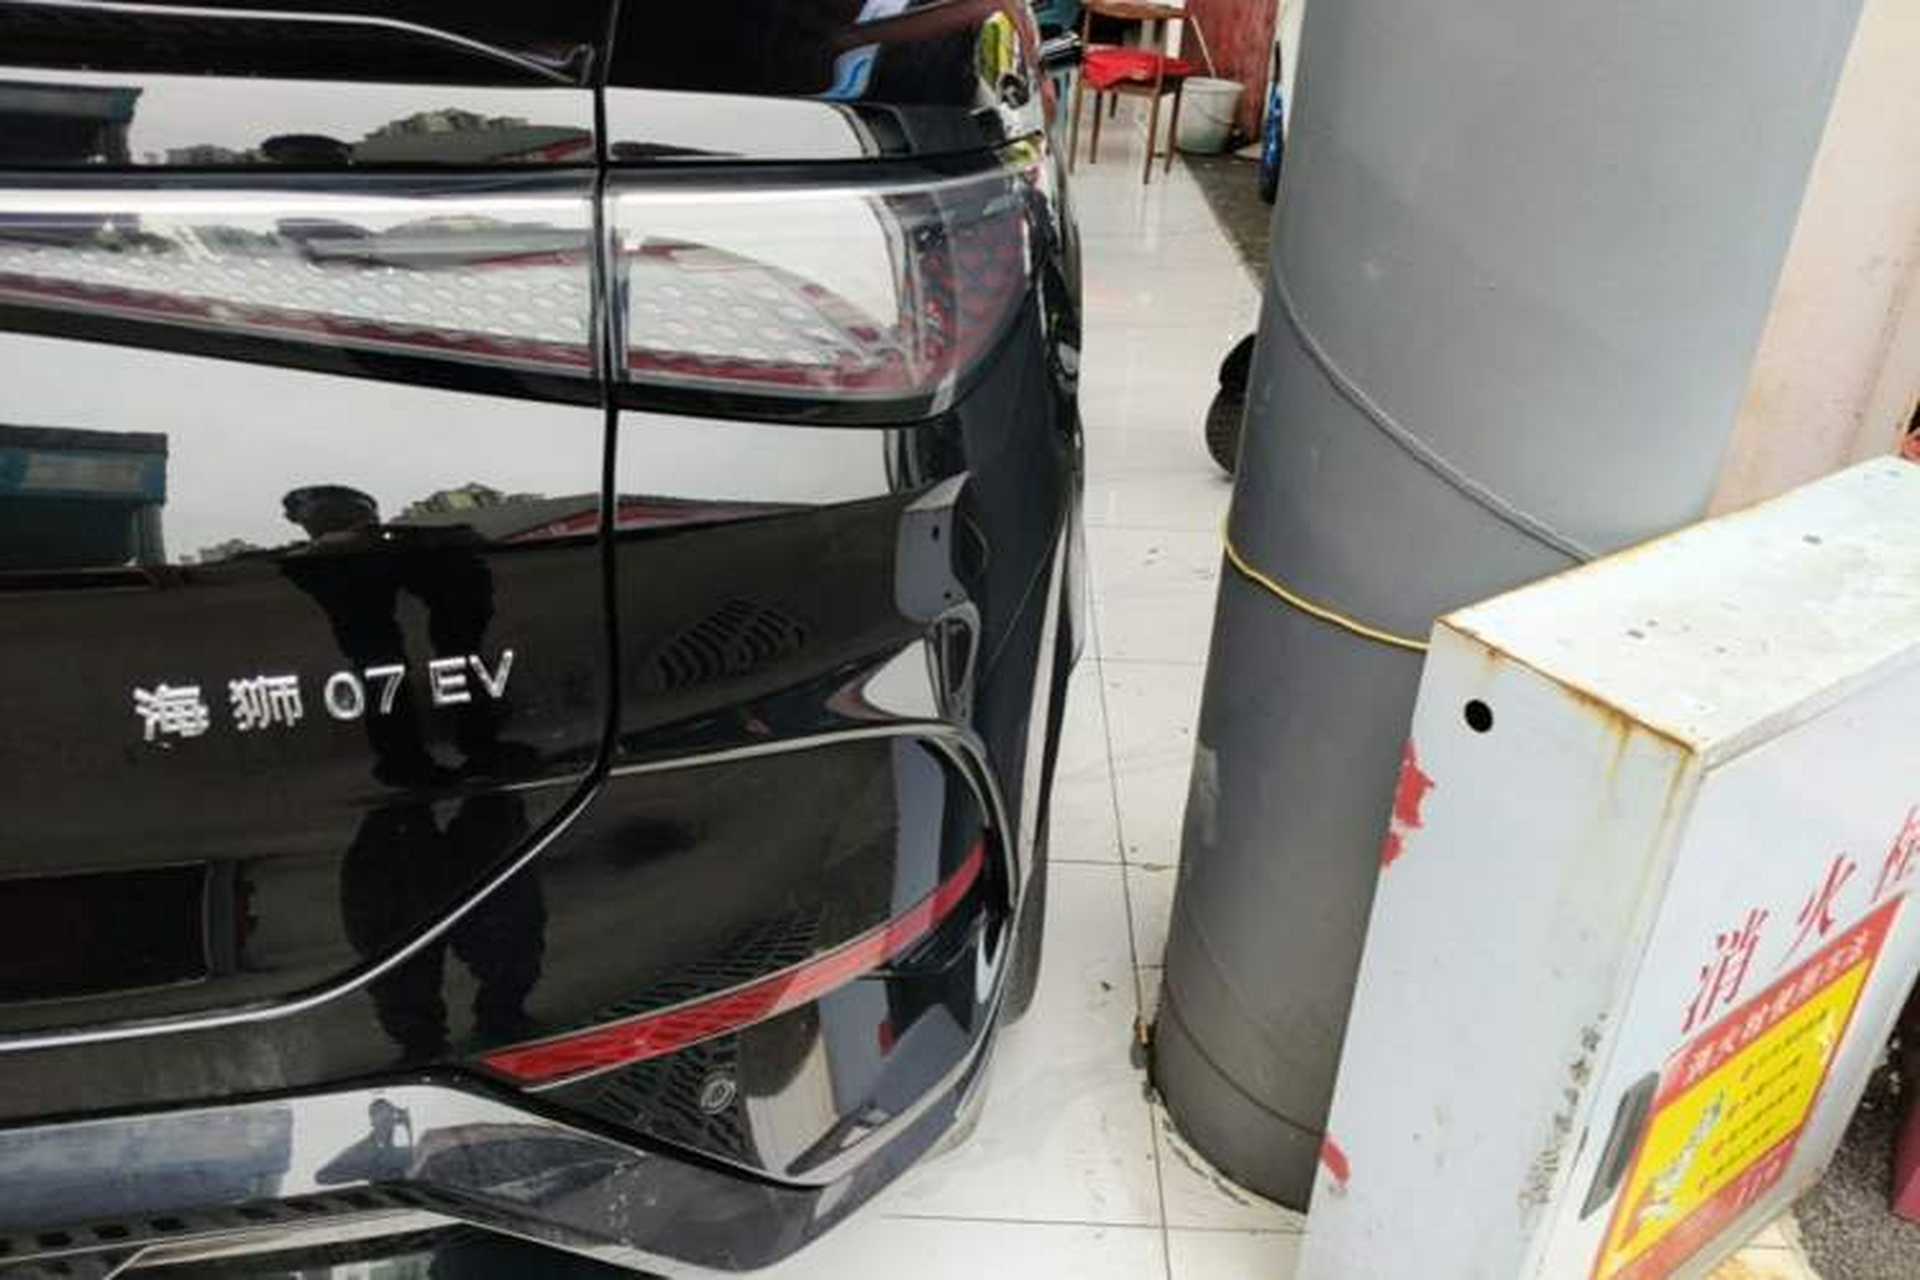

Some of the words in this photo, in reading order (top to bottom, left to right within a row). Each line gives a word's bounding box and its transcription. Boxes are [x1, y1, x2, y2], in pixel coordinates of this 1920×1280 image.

[132, 674, 304, 742] 海狮
[323, 664, 406, 720] 07
[429, 649, 514, 706] EV
